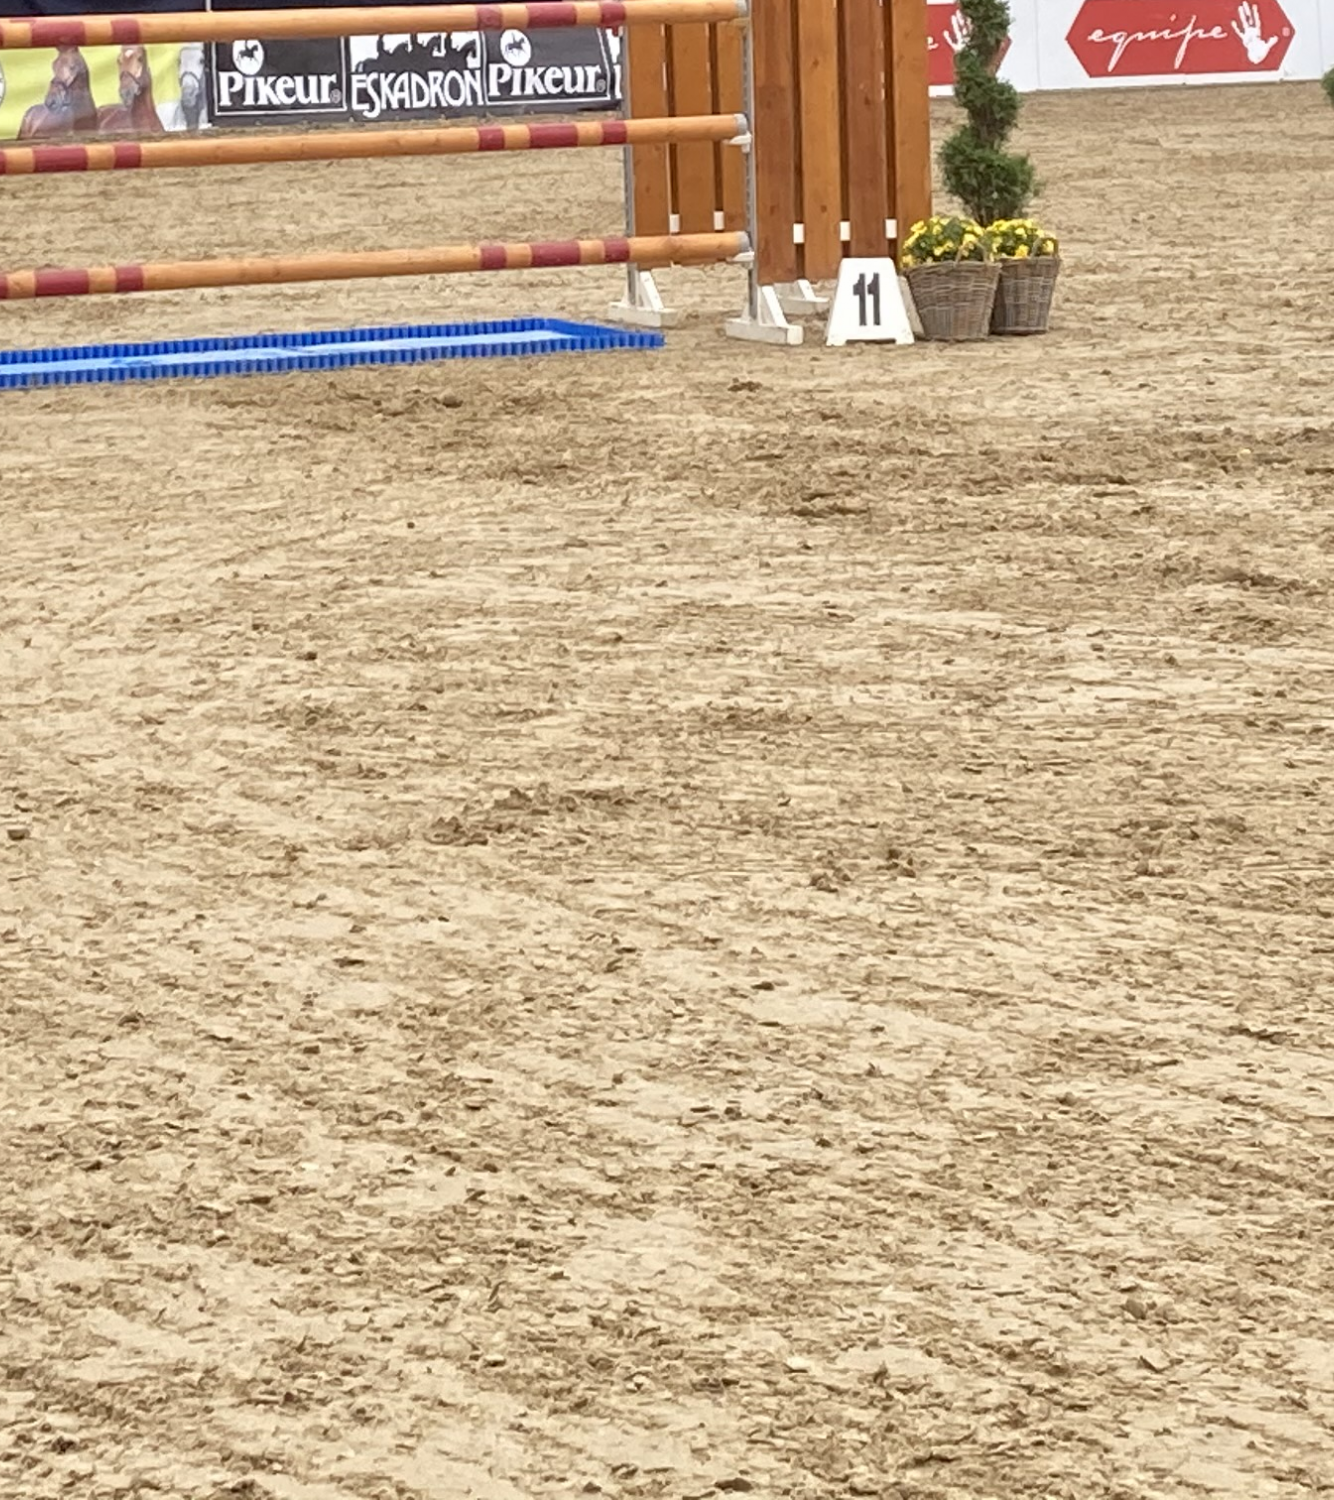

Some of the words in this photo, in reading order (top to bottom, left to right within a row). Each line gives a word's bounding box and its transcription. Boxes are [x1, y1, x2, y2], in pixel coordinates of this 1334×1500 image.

[1086, 14, 1228, 73] equipe
[351, 68, 485, 118] ESKADRON
[852, 271, 882, 327] 11
